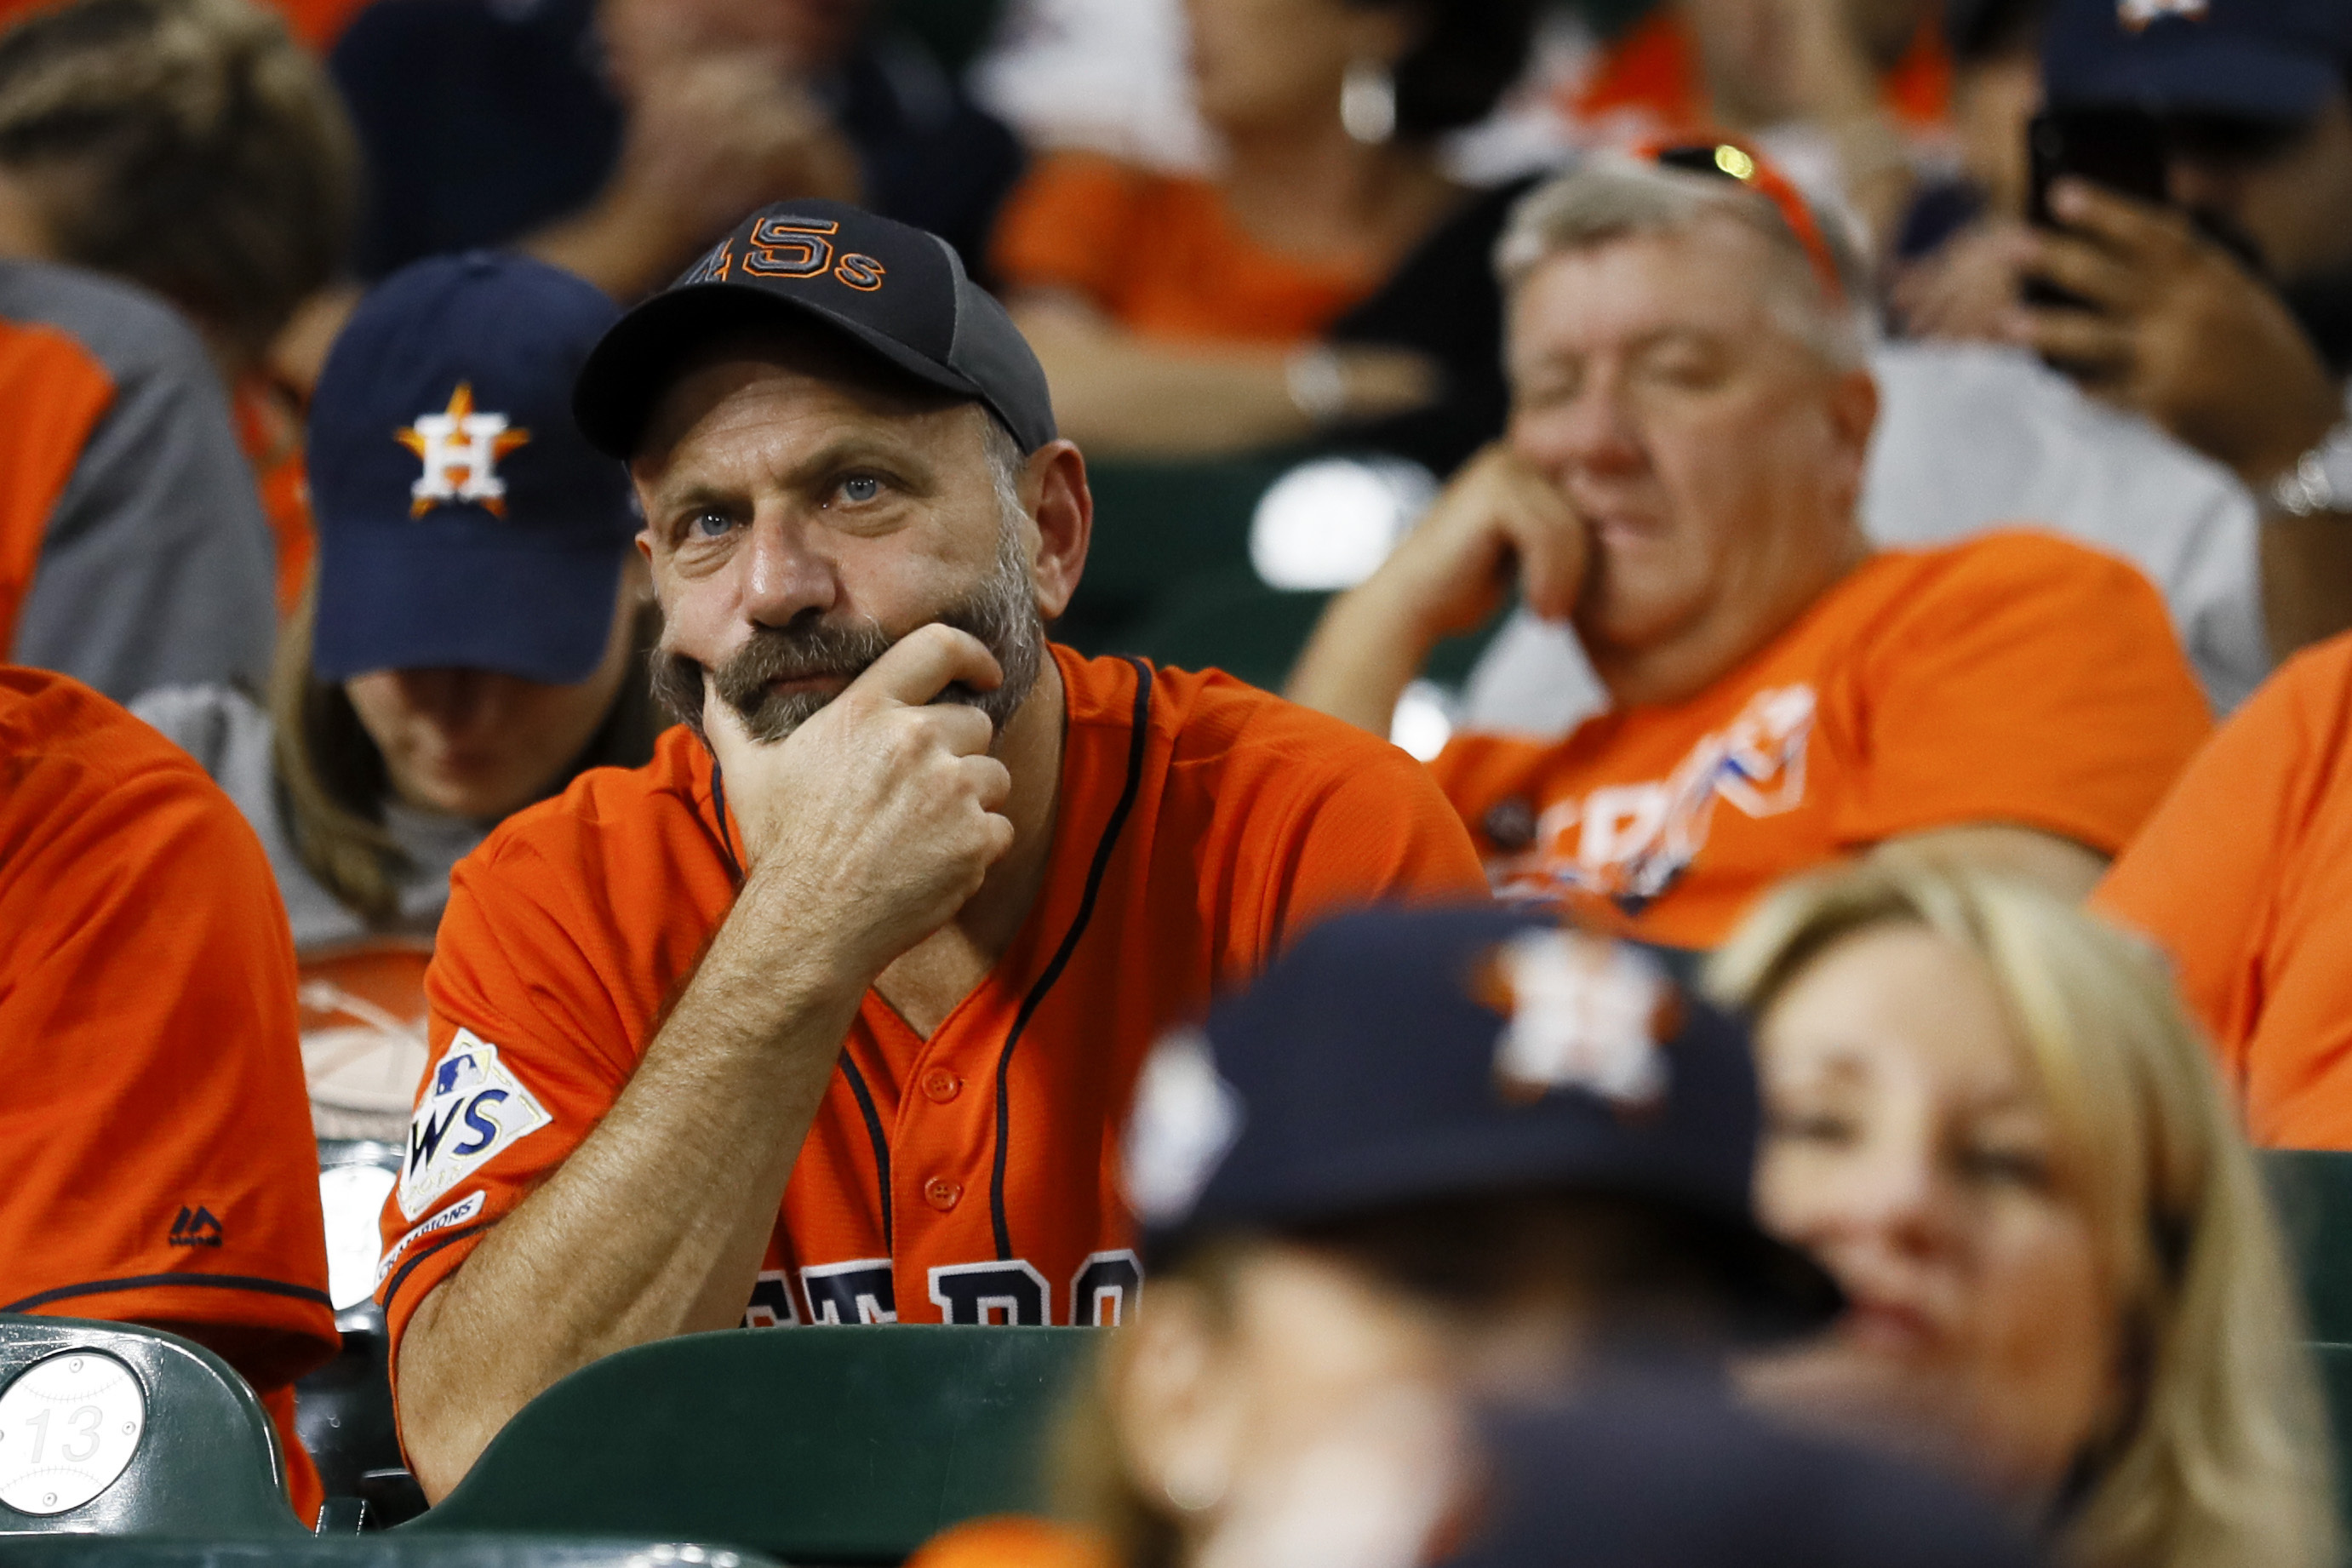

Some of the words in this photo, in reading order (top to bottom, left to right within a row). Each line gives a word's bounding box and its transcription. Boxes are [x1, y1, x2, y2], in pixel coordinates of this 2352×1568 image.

[410, 411, 510, 503] H
[409, 1089, 511, 1181] WS
[378, 1199, 474, 1280] CHPIONS
[26, 1405, 103, 1464] 13
